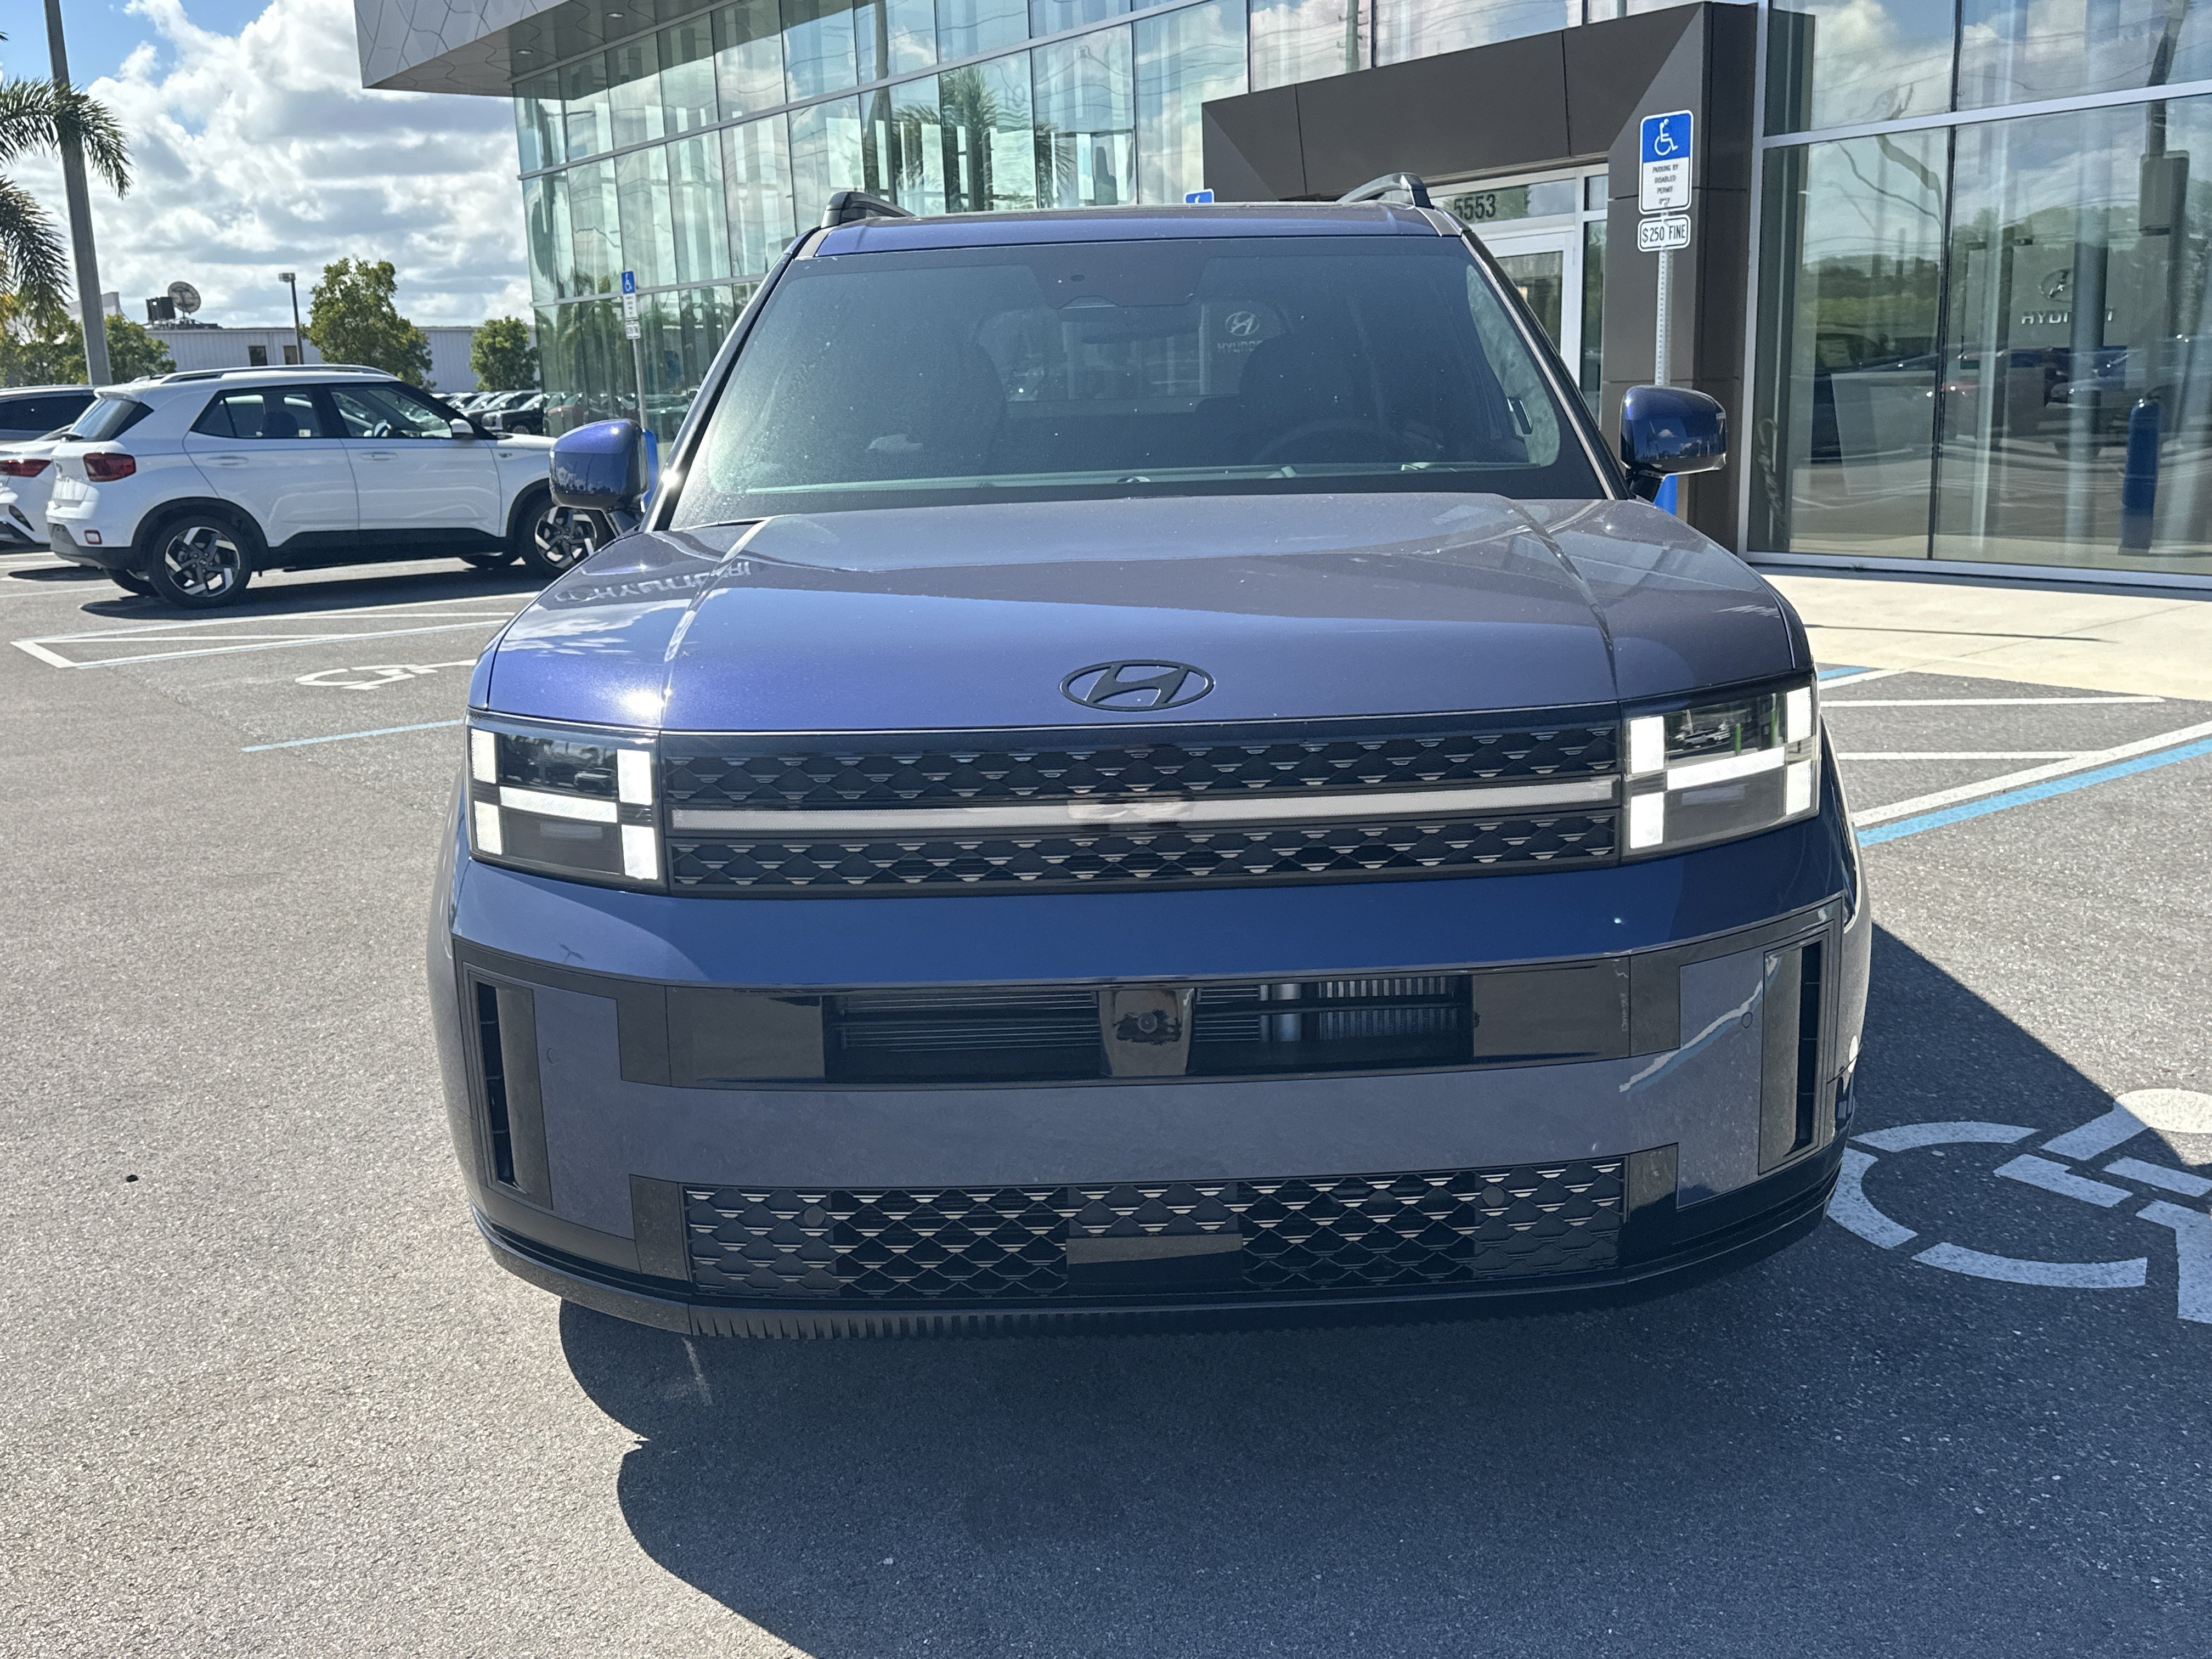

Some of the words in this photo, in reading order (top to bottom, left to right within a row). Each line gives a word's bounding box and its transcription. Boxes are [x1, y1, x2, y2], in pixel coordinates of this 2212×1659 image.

[1652, 165, 1671, 173] PARKING
[1655, 175, 1677, 184] DISABLED
[1657, 185, 1673, 194] PERMIT
[1454, 194, 1496, 221] 5553
[1642, 227, 1664, 243] $250
[1668, 224, 1686, 240] FINE
[2021, 308, 2113, 325] HYUI
